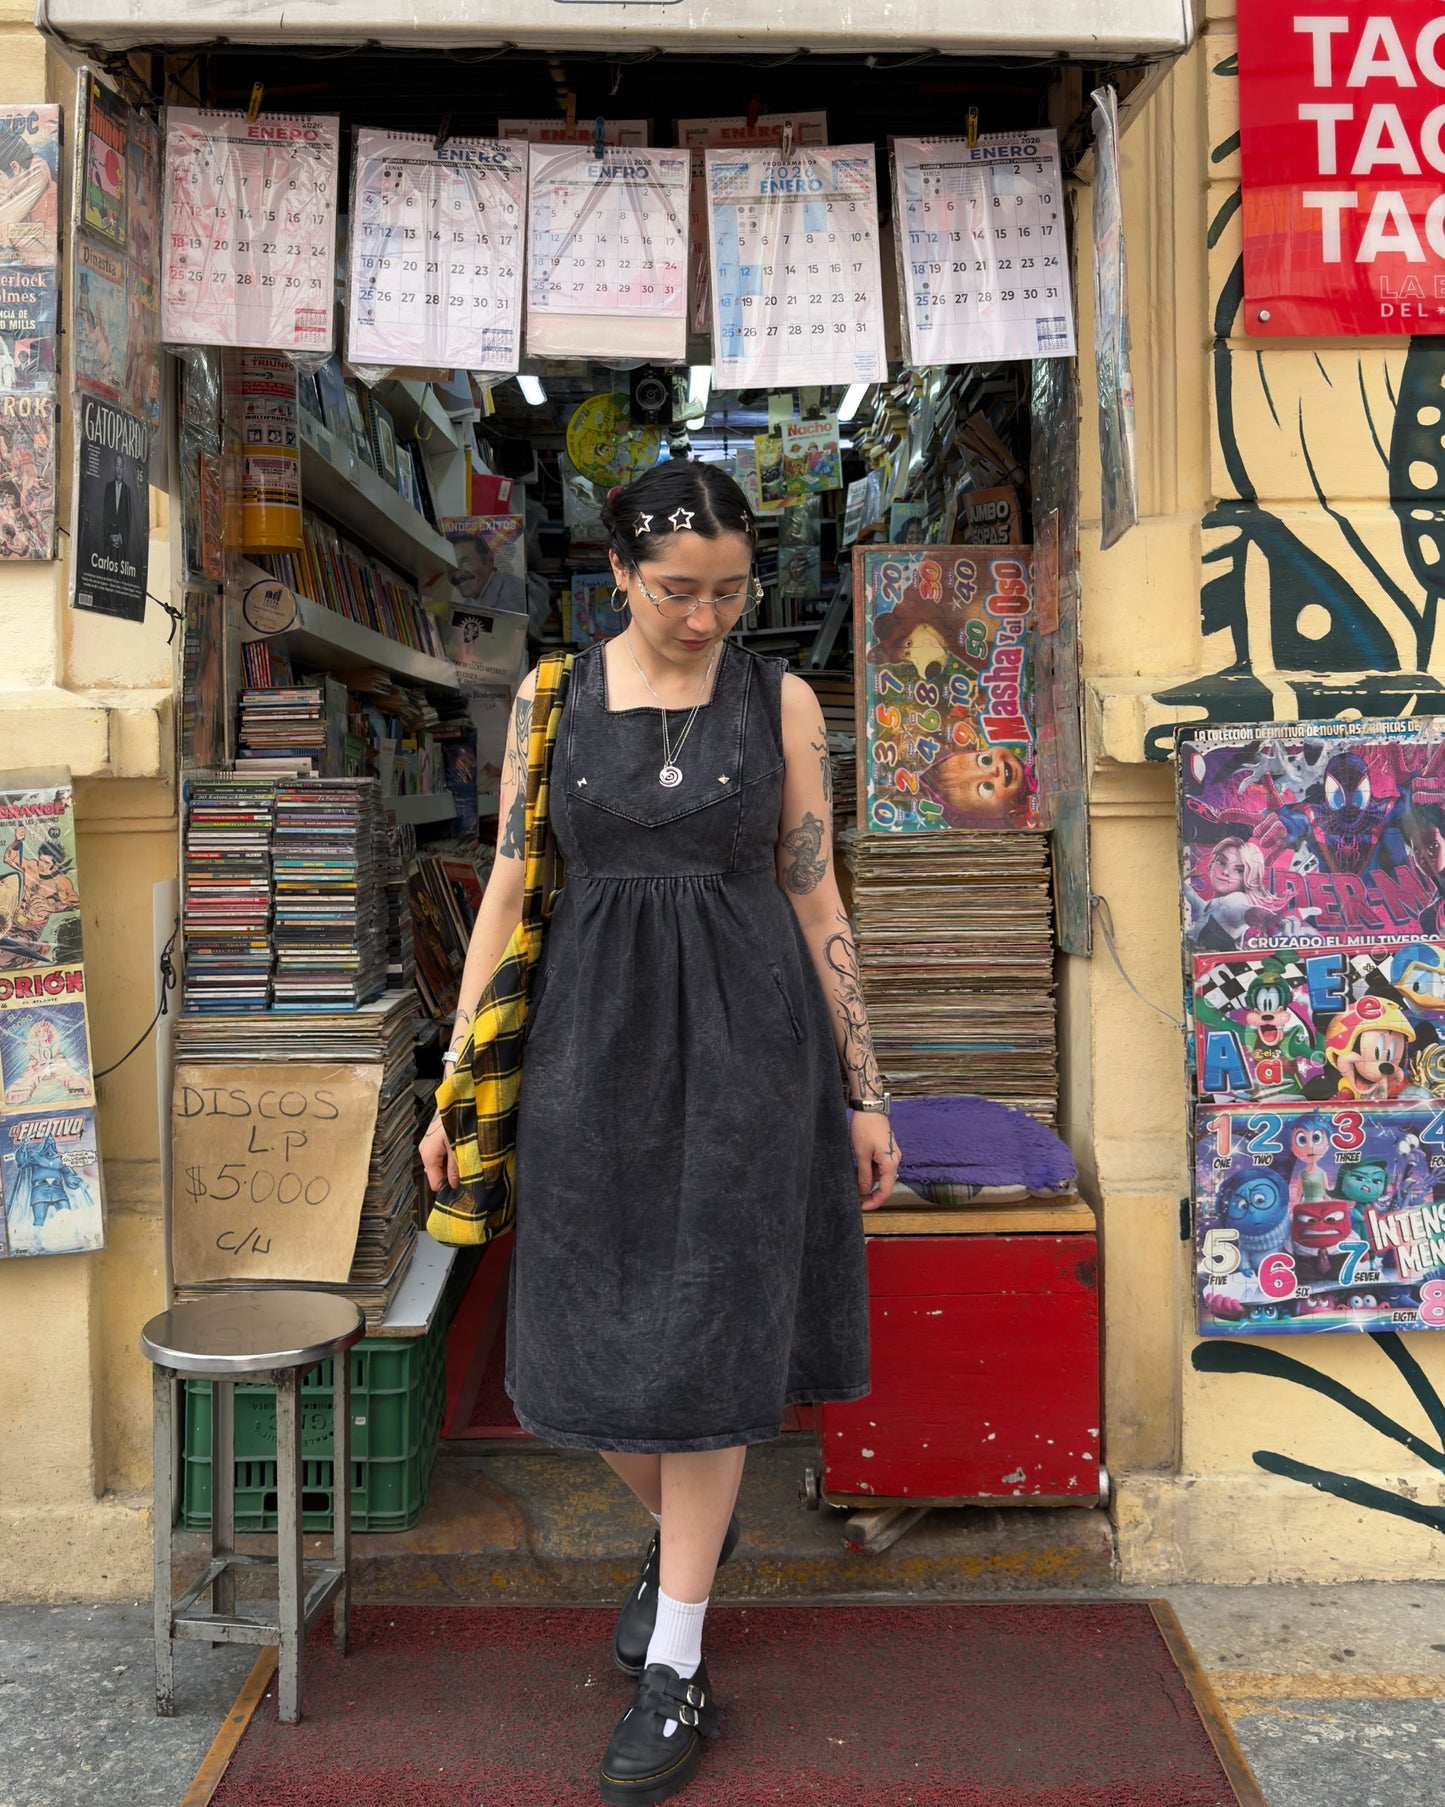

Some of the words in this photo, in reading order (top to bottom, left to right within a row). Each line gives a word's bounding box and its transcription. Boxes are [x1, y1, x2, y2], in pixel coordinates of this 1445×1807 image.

[437, 150, 507, 163] ENERO
[971, 146, 1037, 160] ENERO
[588, 166, 649, 179] ENERO
[765, 167, 814, 179] 2026
[1014, 165, 1021, 174] 2
[1037, 164, 1043, 173] 3
[760, 179, 823, 194] ENERO
[909, 204, 916, 212] 4
[924, 203, 930, 212] 5
[947, 202, 954, 211] 6
[970, 200, 976, 208] 7
[994, 198, 1000, 207] 8
[1017, 197, 1023, 205] 9
[1039, 195, 1051, 204] 10
[911, 234, 919, 243] 11
[927, 234, 938, 243] 12
[950, 233, 960, 241] 13
[995, 229, 1007, 238] 15
[1018, 228, 1030, 237] 16
[1041, 226, 1052, 235] 17
[913, 265, 925, 274] 18
[930, 264, 941, 273] 19
[953, 263, 966, 272] 20
[976, 261, 986, 271] 21
[999, 260, 1012, 269] 22
[1021, 259, 1034, 268] 23
[1044, 257, 1058, 266] 24
[916, 296, 929, 306] 25
[932, 295, 945, 305] 26
[955, 294, 968, 303] 27
[978, 293, 992, 302] 28
[1001, 291, 1015, 300] 29
[1024, 289, 1038, 299] 30
[1046, 288, 1058, 297] 31
[1380, 275, 1425, 298] LA
[19, 310, 28, 318] DE
[1380, 303, 1428, 318] DEL
[9, 320, 35, 329] MILLS
[251, 359, 294, 371] TRIUNFO
[86, 402, 148, 463] GATOPARDO
[787, 422, 832, 436] Nacho
[970, 500, 1009, 523] JUMBO
[91, 553, 118, 573] Carlos
[120, 560, 136, 578] Slim
[881, 562, 903, 603] 20
[919, 560, 942, 604] 30
[954, 559, 977, 603] 40
[987, 561, 1031, 615] Oso
[1003, 618, 1023, 634] el
[965, 619, 987, 659] 50
[997, 633, 1015, 644] y
[879, 670, 903, 695] 7
[949, 675, 971, 707] 10
[915, 682, 940, 707] 8
[981, 647, 1031, 742] Masha
[876, 704, 901, 730] 5
[917, 709, 940, 732] 6
[952, 722, 977, 746] 9
[1194, 730, 1206, 741] LA
[1255, 726, 1304, 739] DEFINITIVA
[1306, 725, 1319, 736] DE
[872, 741, 898, 766] 3
[916, 736, 939, 763] 4
[895, 768, 919, 794] 2
[872, 801, 896, 826] 0
[919, 799, 943, 815] 1
[1248, 936, 1323, 948] CRUZADO
[1326, 936, 1341, 947] EL
[0, 971, 84, 1000] ORIÓN
[1306, 953, 1350, 1013] E
[1355, 995, 1384, 1019] e
[1203, 1031, 1252, 1092] A
[1255, 1058, 1284, 1085] a
[177, 1086, 339, 1120] DISCOS
[19, 1118, 84, 1141] FUGITIVO
[1208, 1113, 1233, 1157] 1
[1247, 1113, 1283, 1154] 2
[1330, 1110, 1365, 1150] 3
[1213, 1158, 1232, 1169] ONE
[1253, 1155, 1273, 1165] TWO
[1335, 1153, 1361, 1163] THREE
[1203, 1229, 1241, 1275] 5
[1337, 1241, 1369, 1286] 7
[1210, 1276, 1228, 1285] FIVE
[1258, 1253, 1297, 1299] 6
[1355, 1272, 1380, 1282] SEVEN
[1295, 1287, 1310, 1297] SIX
[1419, 1280, 1445, 1326] 8
[1392, 1311, 1417, 1322] EIGTH
